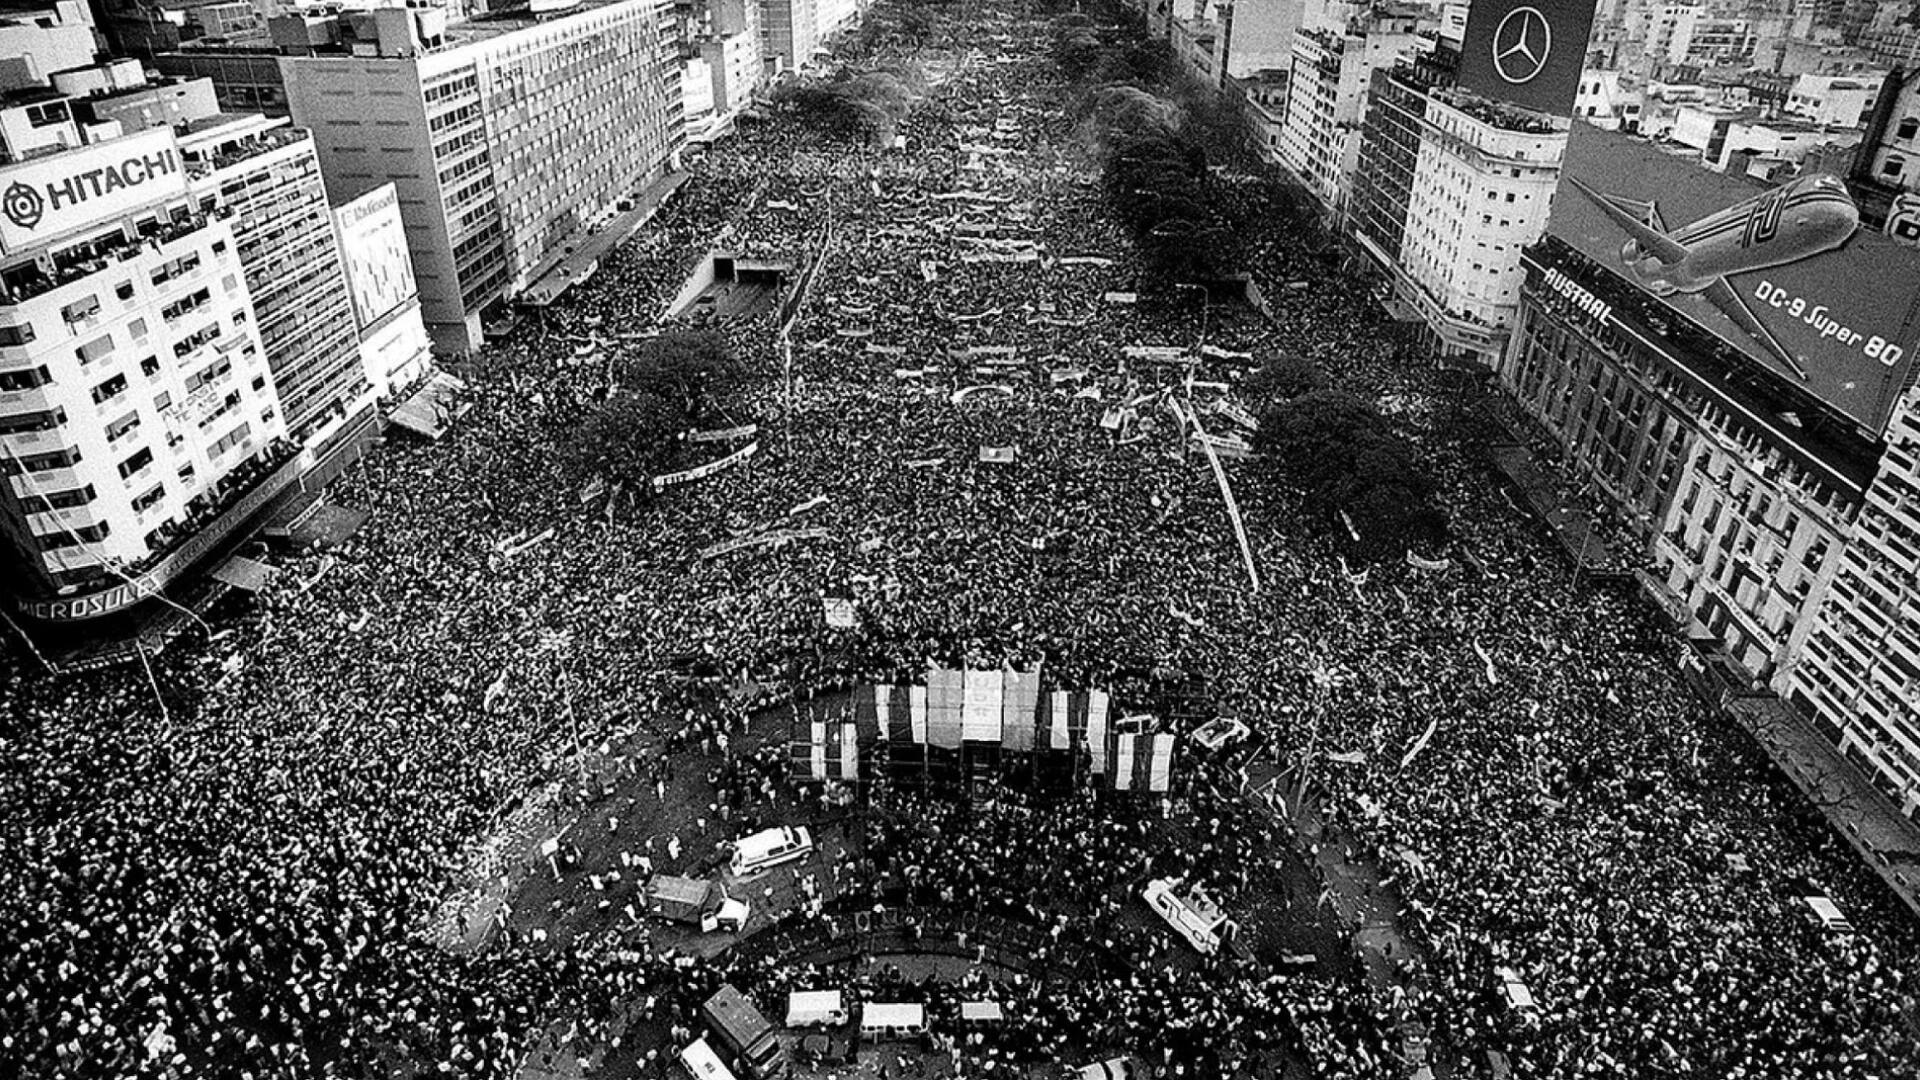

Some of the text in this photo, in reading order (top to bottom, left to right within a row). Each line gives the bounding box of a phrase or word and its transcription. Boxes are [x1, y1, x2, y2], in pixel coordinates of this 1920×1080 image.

[46, 149, 176, 211] HITACHI
[1544, 267, 1612, 327] AUSTRAL
[1803, 305, 1863, 346] Super
[1863, 335, 1904, 367] 80
